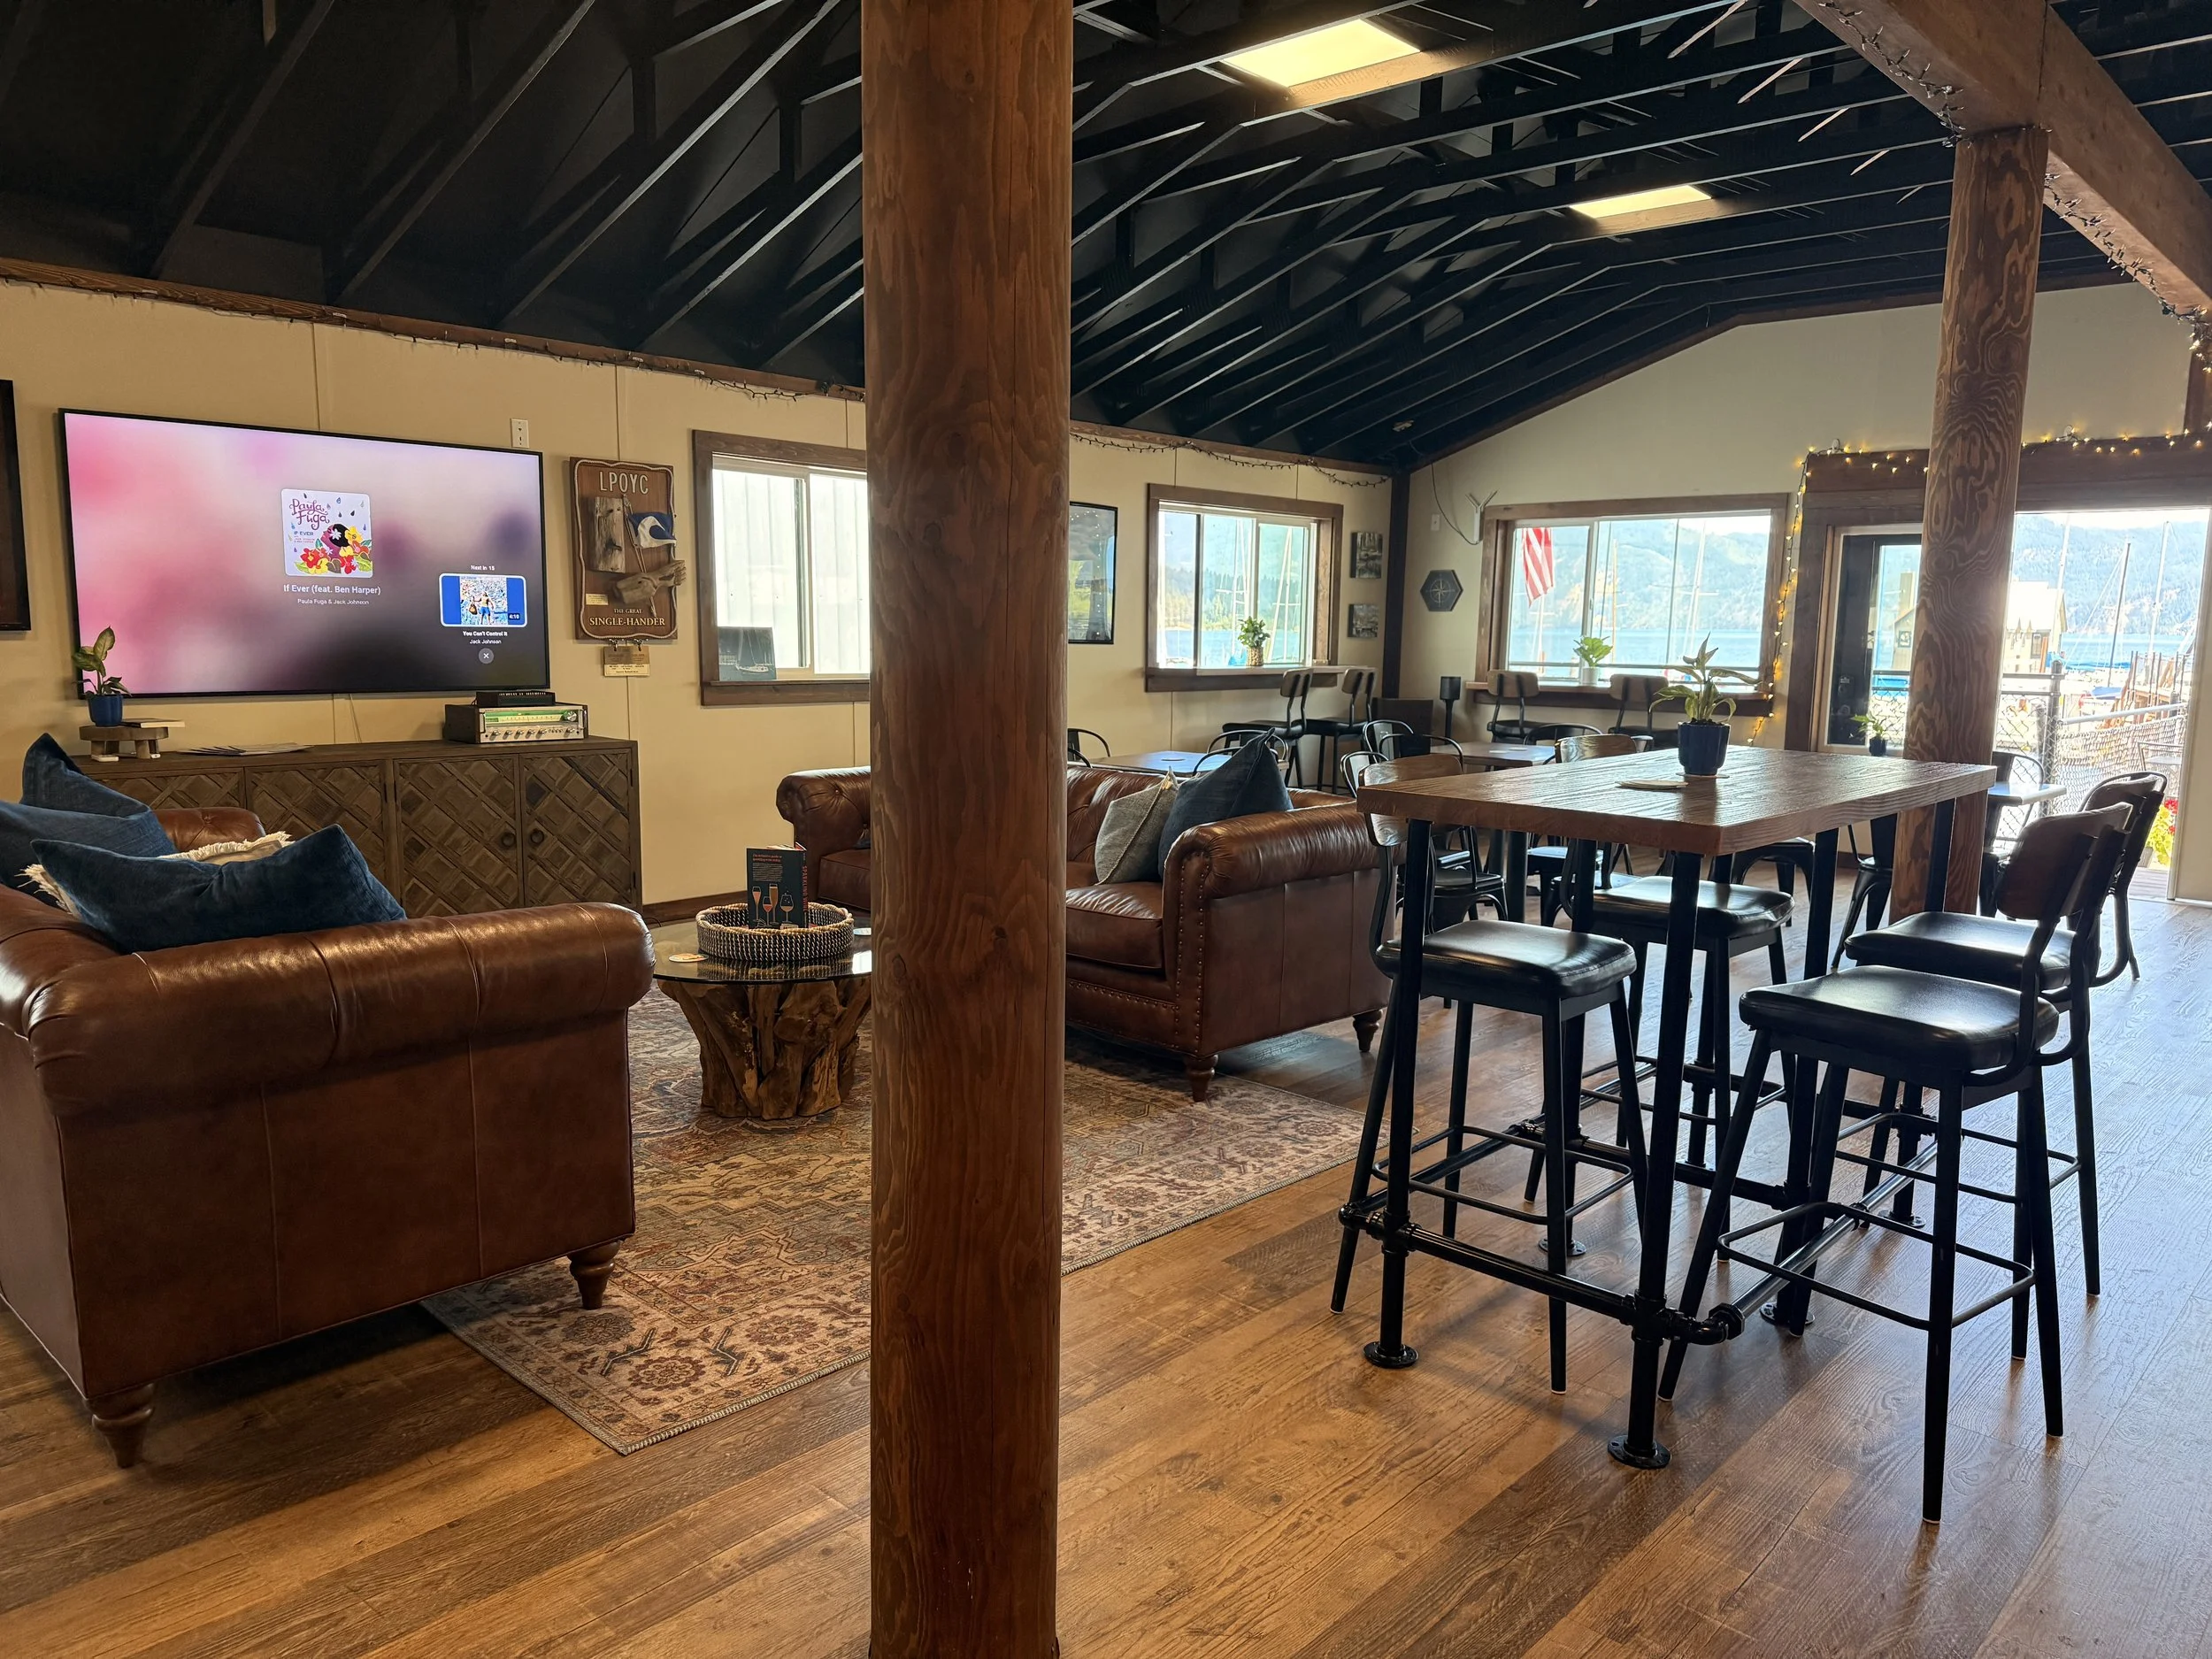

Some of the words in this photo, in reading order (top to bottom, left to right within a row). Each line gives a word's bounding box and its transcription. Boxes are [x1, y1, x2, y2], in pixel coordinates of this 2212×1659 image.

[599, 471, 649, 495] LPOYC
[296, 511, 330, 531] Fuga
[311, 584, 333, 595] (feat.
[334, 585, 350, 594] Ben
[351, 586, 381, 595] Harper)
[589, 617, 665, 626] SINGLE-HANDER
